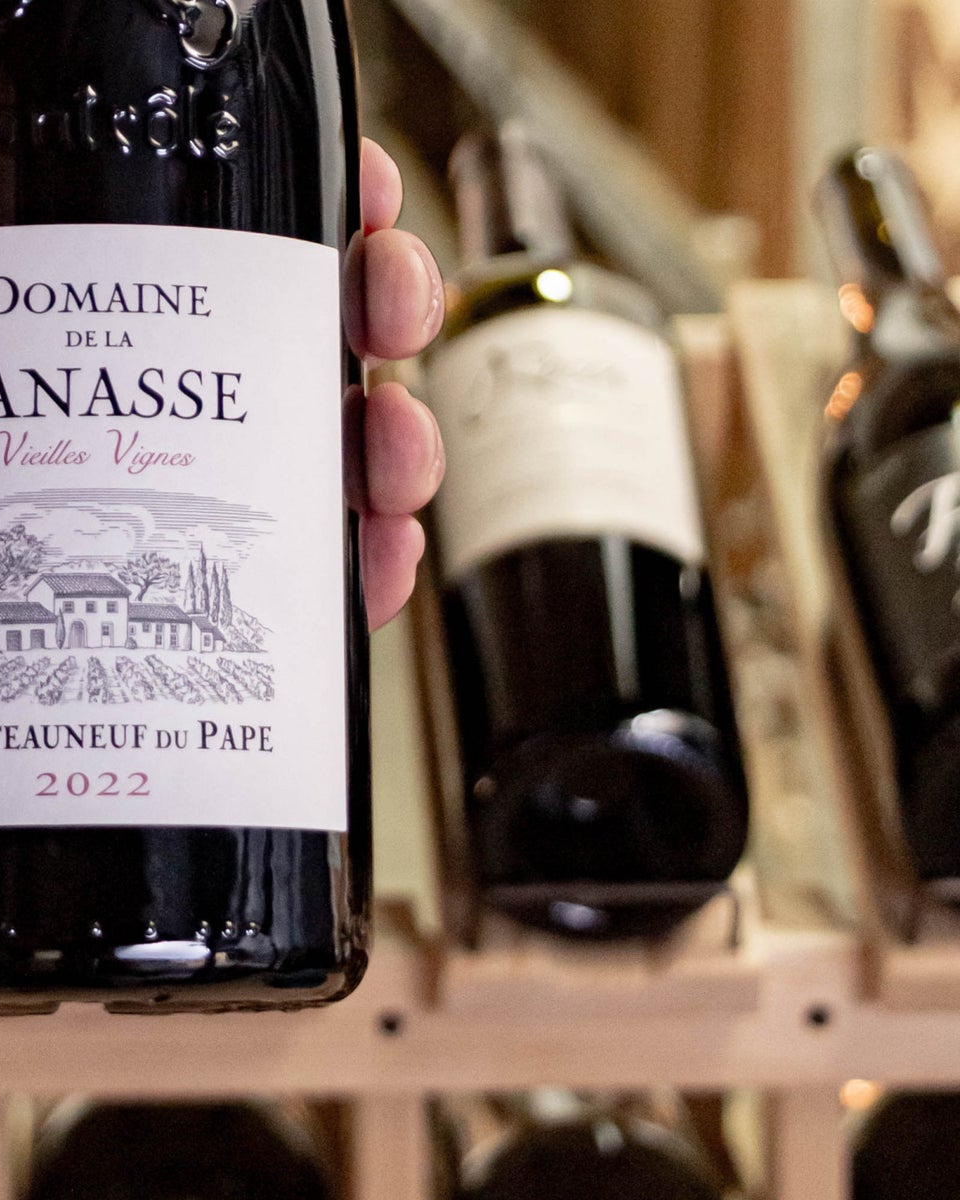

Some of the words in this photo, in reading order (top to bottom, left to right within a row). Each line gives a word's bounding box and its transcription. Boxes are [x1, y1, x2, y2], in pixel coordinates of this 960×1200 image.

[65, 330, 98, 348] DE
[104, 330, 134, 348] LA
[106, 428, 195, 475] Vignes
[155, 729, 189, 750] DU
[197, 720, 274, 753] PAPE
[34, 771, 152, 797] 2022
